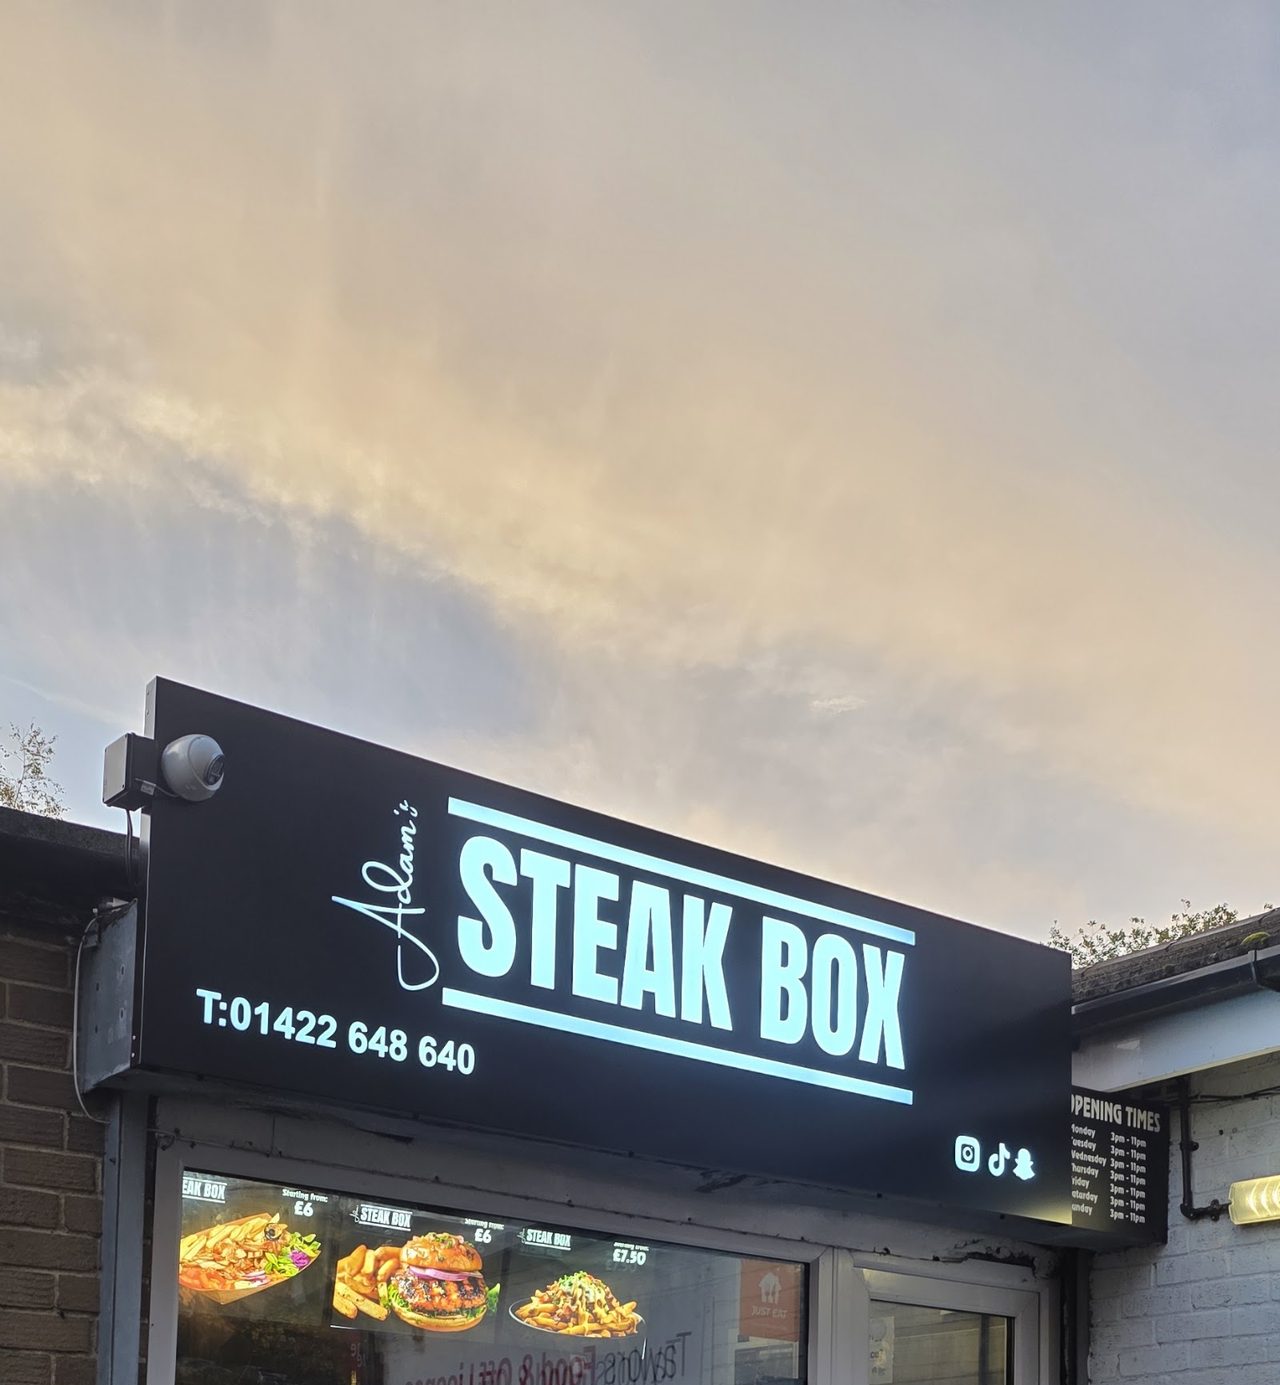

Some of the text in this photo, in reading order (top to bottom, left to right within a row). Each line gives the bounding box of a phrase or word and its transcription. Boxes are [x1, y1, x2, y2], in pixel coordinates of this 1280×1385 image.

[331, 799, 440, 991] Adam's
[457, 835, 906, 1070] STEAK BOX
[196, 988, 476, 1076] T:01422 648 640
[1125, 1106, 1161, 1133] TIMES
[1071, 1137, 1097, 1152] uesday
[1110, 1145, 1125, 1158] 3pm
[1130, 1149, 1146, 1161] 11pm
[1110, 1132, 1125, 1145] 3pm
[1130, 1136, 1146, 1148] 11pm
[1110, 1158, 1125, 1171] 3pm
[1130, 1162, 1146, 1174] 11pm
[1071, 1177, 1090, 1189] riday
[1110, 1183, 1125, 1196] 3pm
[1130, 1187, 1146, 1199] 11pm
[1110, 1170, 1125, 1183] 3pm
[1130, 1174, 1146, 1186] 11pm
[182, 1179, 226, 1200] EAK BOX
[282, 1188, 309, 1201] Starting
[294, 1200, 314, 1217] £6
[1071, 1190, 1098, 1204] aturday
[1110, 1196, 1125, 1208] 3pm
[1130, 1199, 1146, 1211] 11pm
[360, 1207, 391, 1226] STEAK
[391, 1211, 411, 1228] BOX
[1110, 1208, 1125, 1221] 3pm
[1130, 1212, 1146, 1224] 11pm
[474, 1228, 492, 1244] £6
[526, 1228, 553, 1245] STEAK
[553, 1233, 571, 1248] BOX
[612, 1249, 647, 1266] £7.50
[751, 1304, 788, 1319] JUST EAT
